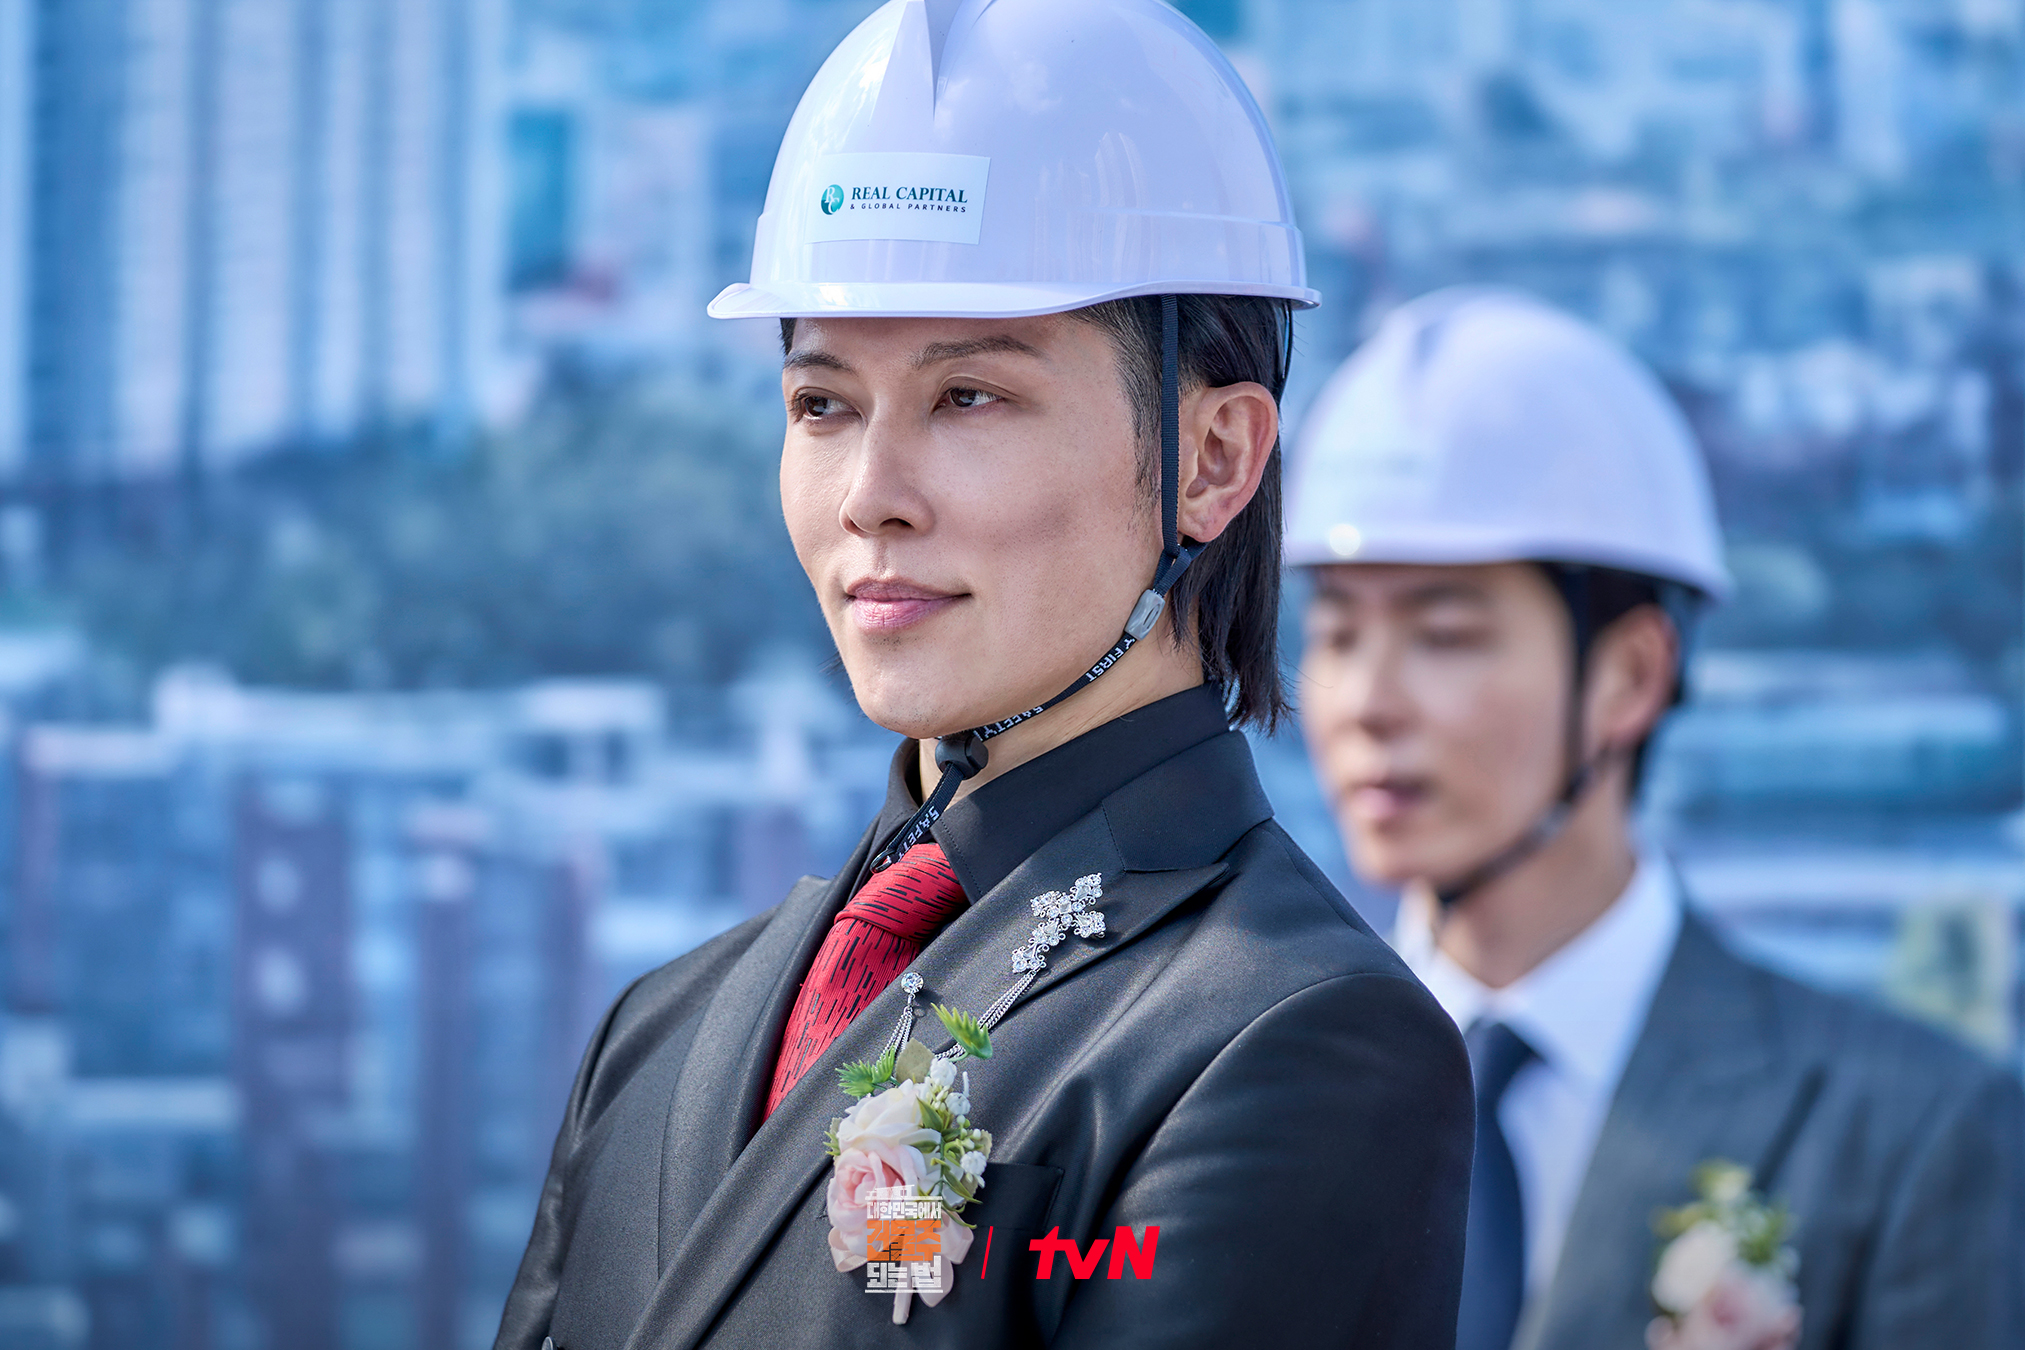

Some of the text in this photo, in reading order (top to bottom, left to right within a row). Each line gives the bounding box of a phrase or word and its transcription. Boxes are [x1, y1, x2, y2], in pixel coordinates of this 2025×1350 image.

[851, 186, 968, 204] REAL CAPITAL
[861, 202, 901, 210] GLOBAL
[907, 203, 967, 213] PARTNERS
[1085, 647, 1124, 682] FIRST
[984, 706, 1044, 739] SAFETY
